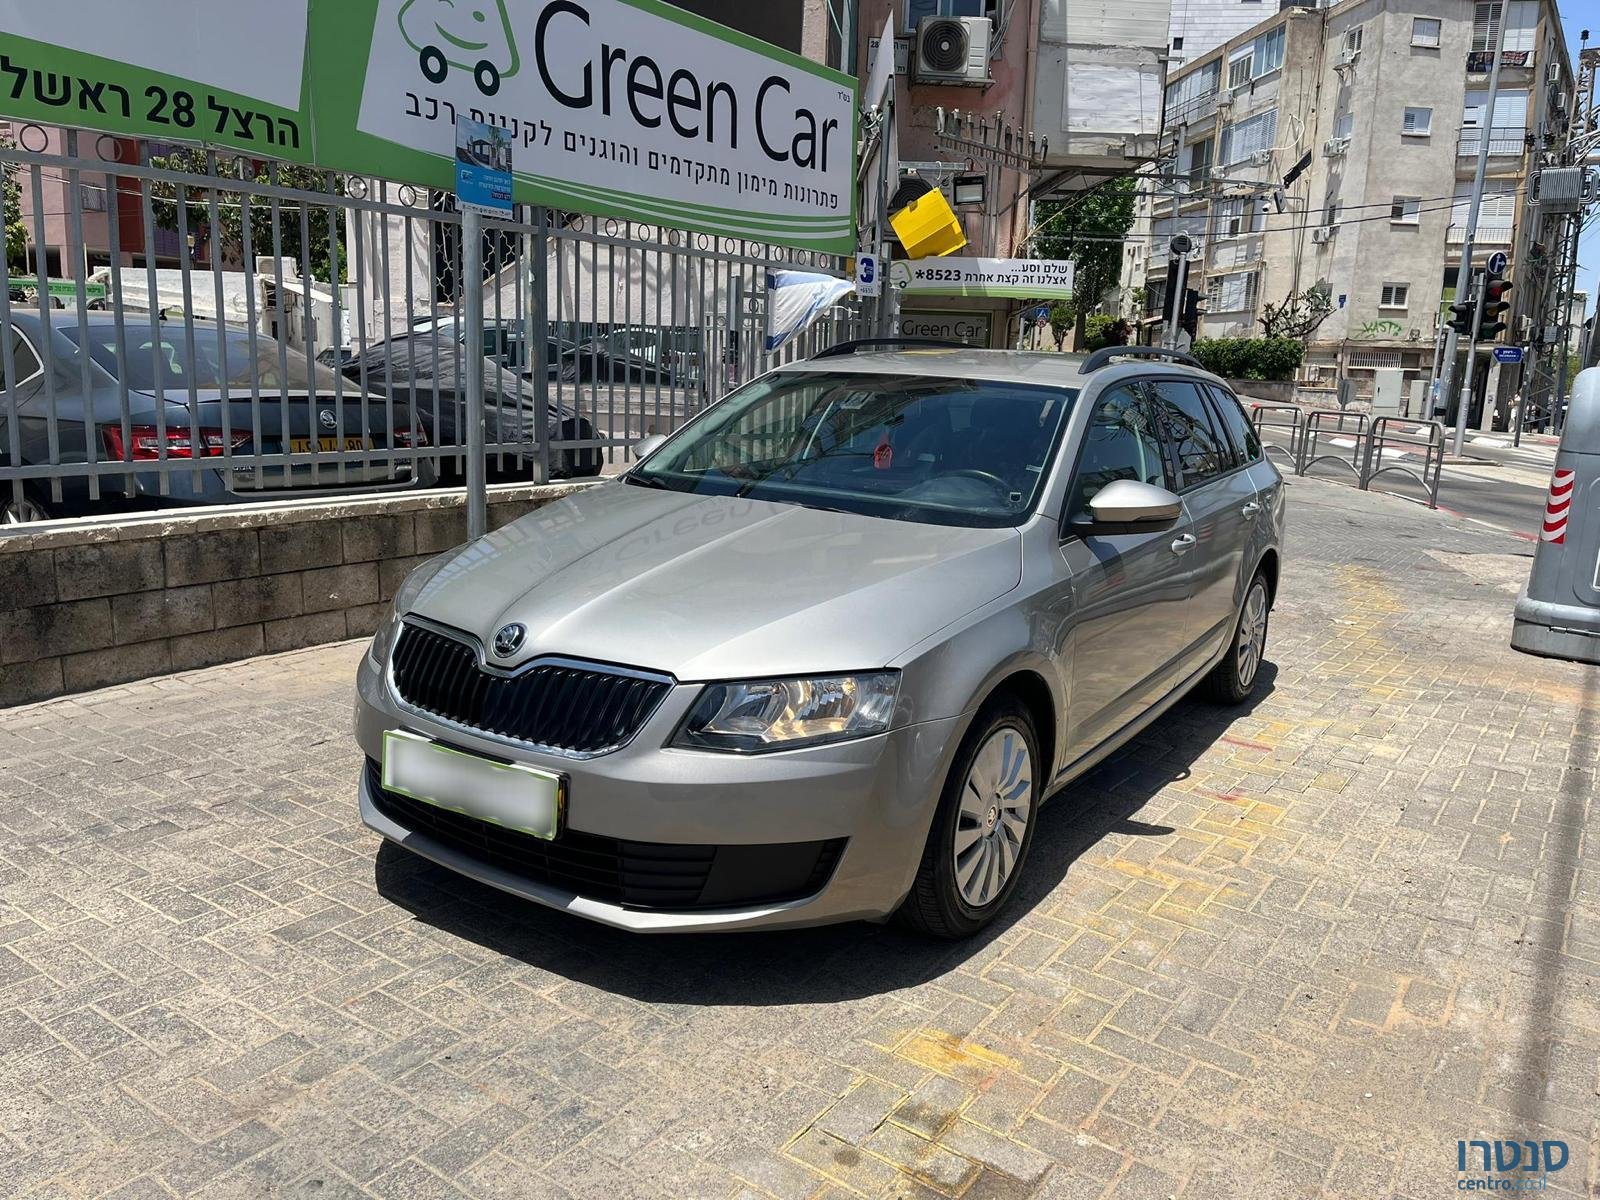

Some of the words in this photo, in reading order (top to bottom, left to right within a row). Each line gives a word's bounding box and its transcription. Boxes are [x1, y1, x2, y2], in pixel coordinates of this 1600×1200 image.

[534, 0, 738, 149] Green
[755, 76, 838, 173] Car
[144, 85, 196, 128] 28
[405, 91, 457, 126] רכב
[207, 95, 299, 148] הרצל
[564, 130, 638, 166] והוגנים
[648, 151, 731, 186] מתקדמים
[737, 171, 778, 196] מימון
[783, 182, 838, 210] פתרונות
[964, 272, 993, 283] אחרת
[996, 273, 1019, 286] קצת
[1022, 274, 1034, 283] זה
[1037, 274, 1067, 285] אצלנו
[1043, 262, 1068, 274] שלם
[901, 319, 950, 337] Green
[954, 321, 982, 338] Car
